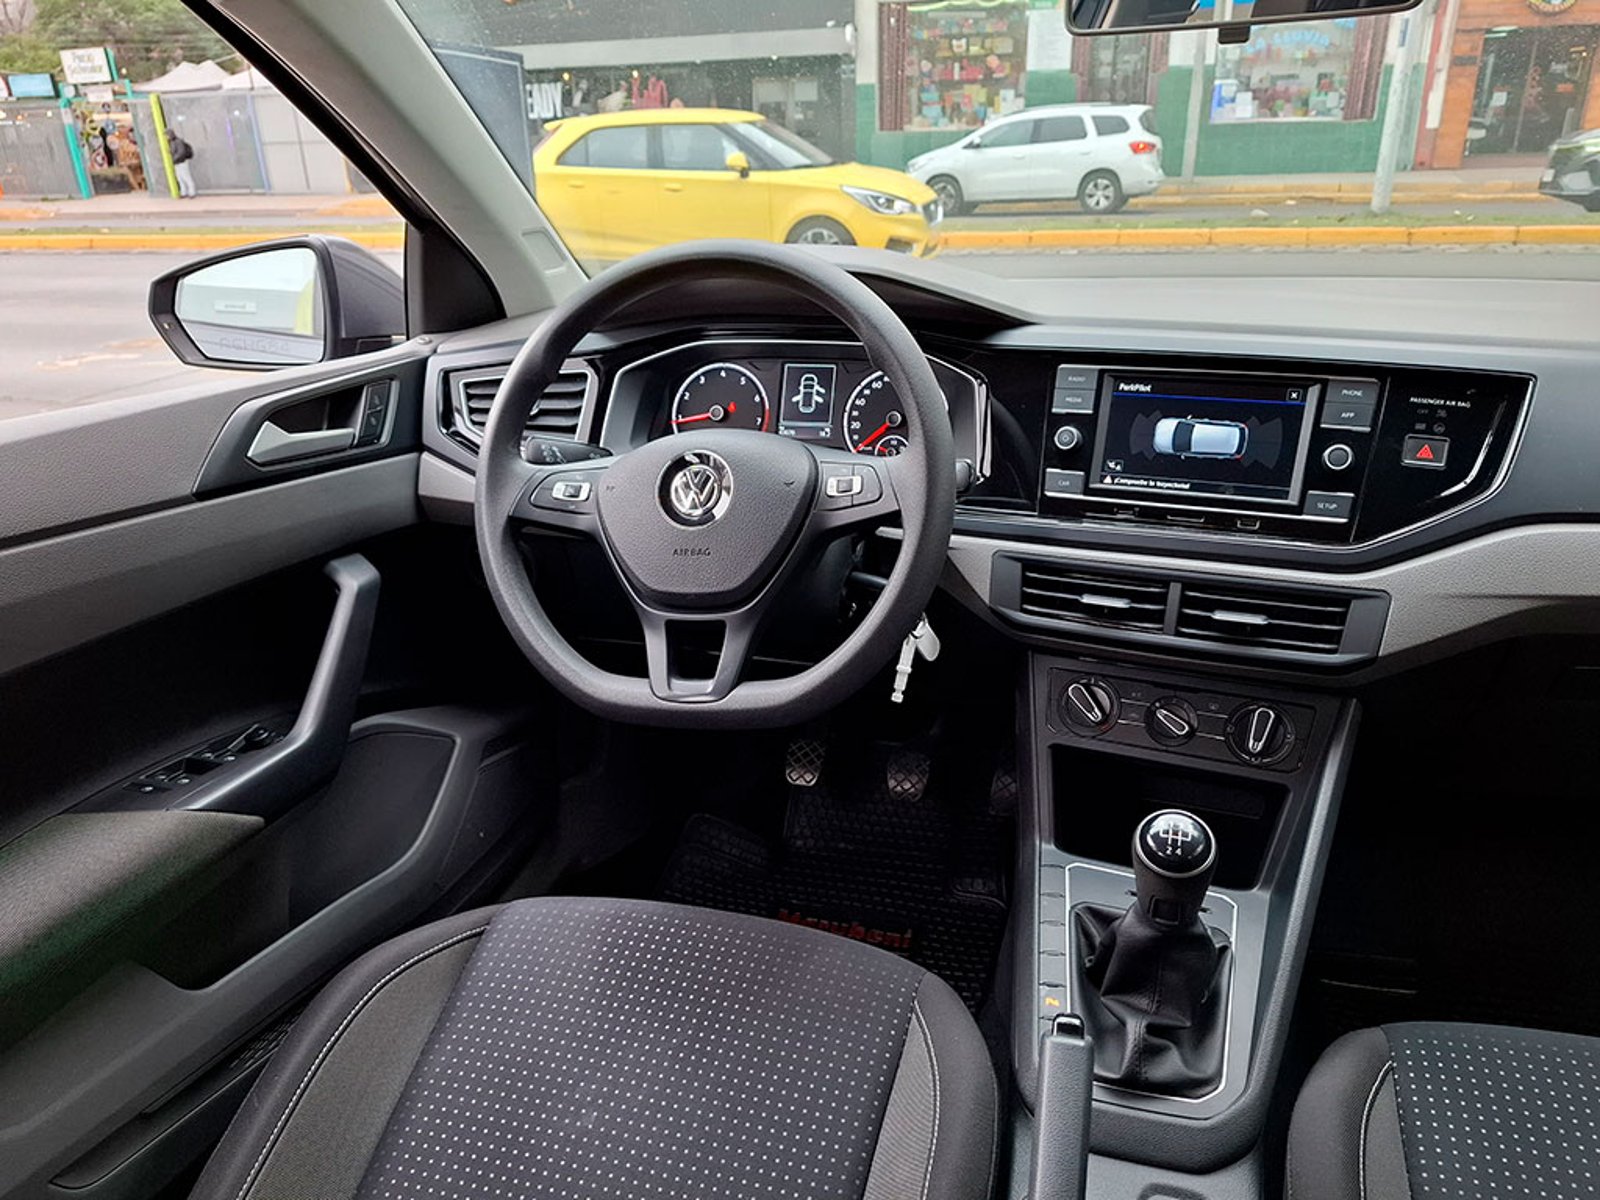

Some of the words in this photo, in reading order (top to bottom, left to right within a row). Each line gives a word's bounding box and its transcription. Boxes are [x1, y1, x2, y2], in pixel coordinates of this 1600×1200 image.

[720, 369, 726, 378] 4
[699, 375, 705, 384] 3
[740, 376, 746, 385] 5
[872, 381, 883, 389] 60
[1118, 382, 1152, 392] ParkPilot
[683, 391, 690, 400] 2
[1341, 389, 1363, 397] PHONE
[753, 394, 760, 402] 6
[855, 398, 866, 406] 40
[1410, 396, 1444, 405] PASSENGER
[1457, 401, 1471, 409] BAG
[756, 417, 762, 426] 7
[850, 421, 861, 429] 20
[1316, 502, 1338, 510] SETUP
[673, 547, 711, 557] AIRBAG
[1166, 845, 1172, 855] 2
[1174, 848, 1182, 856] 4
